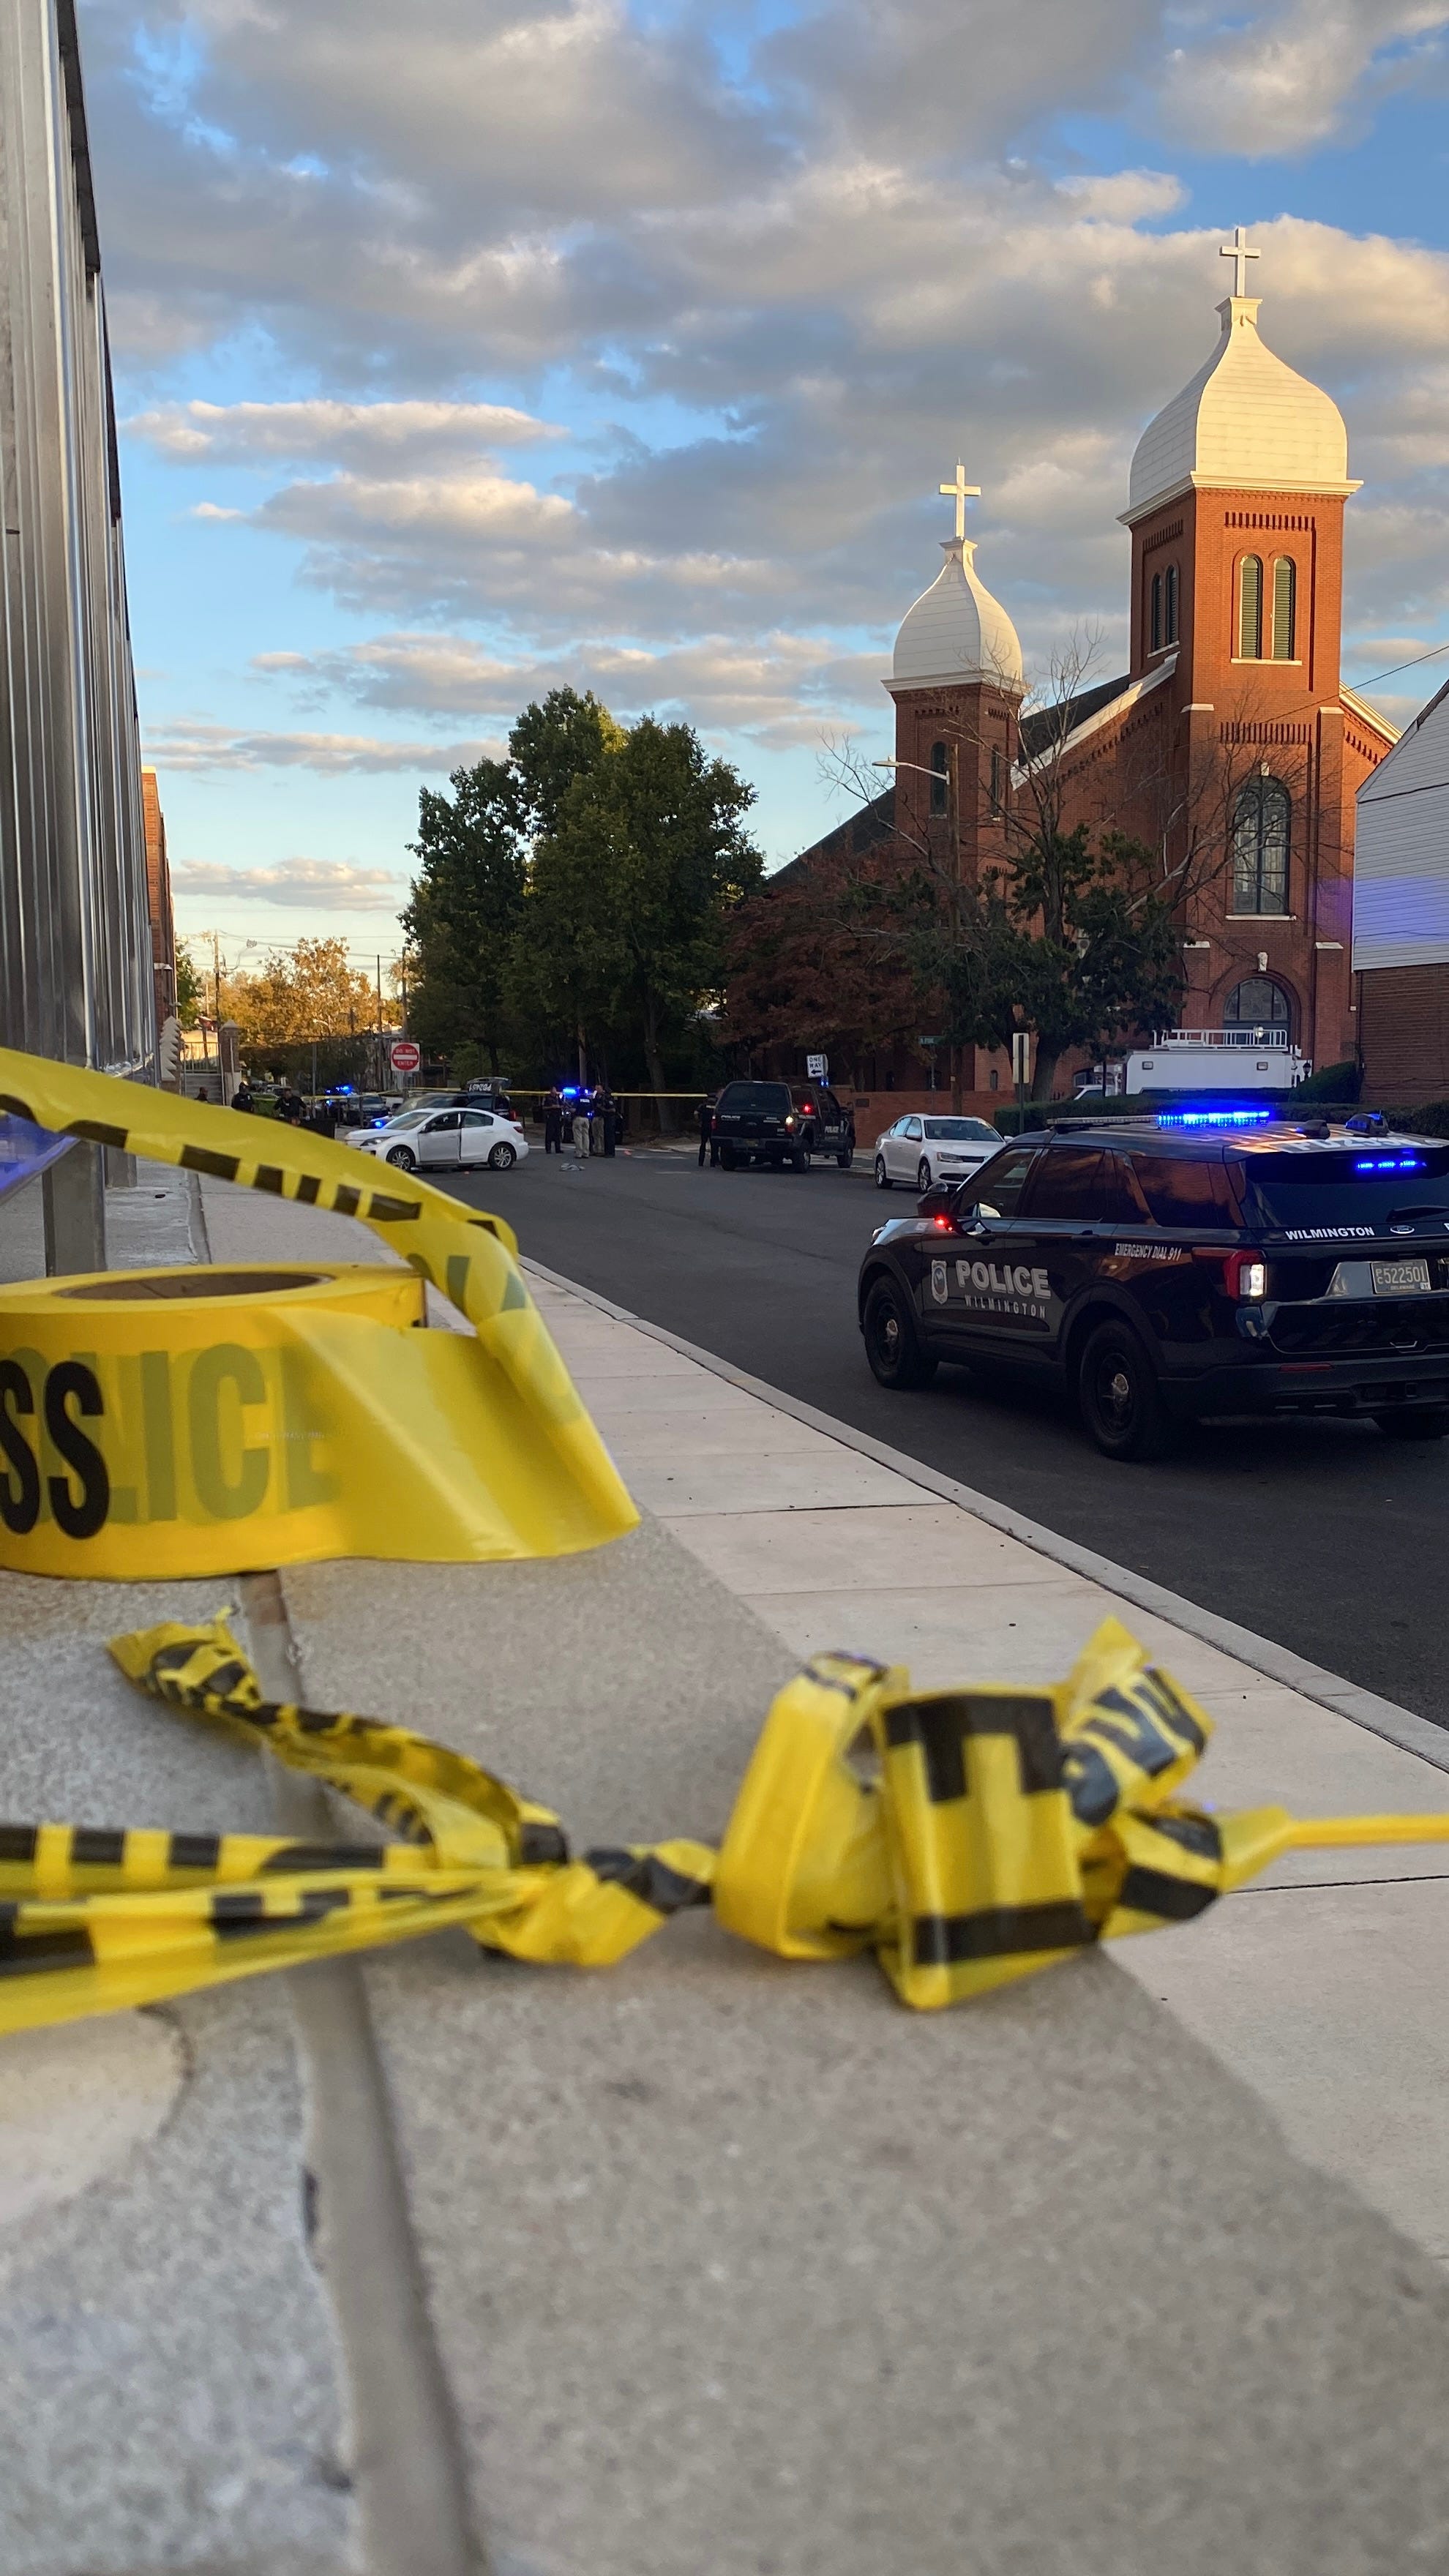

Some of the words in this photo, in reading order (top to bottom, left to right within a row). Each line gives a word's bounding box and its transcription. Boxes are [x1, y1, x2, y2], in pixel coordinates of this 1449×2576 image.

[824, 1126, 839, 1134] POLICE
[1285, 1227, 1375, 1240] WILMINGTON
[1115, 1243, 1153, 1258] EMERGENCY
[1151, 1246, 1167, 1259] DIAL
[1167, 1247, 1182, 1261] 911
[956, 1259, 1052, 1300] POLICE
[1383, 1266, 1426, 1284] 522501
[965, 1294, 1046, 1319] WILMINGTON
